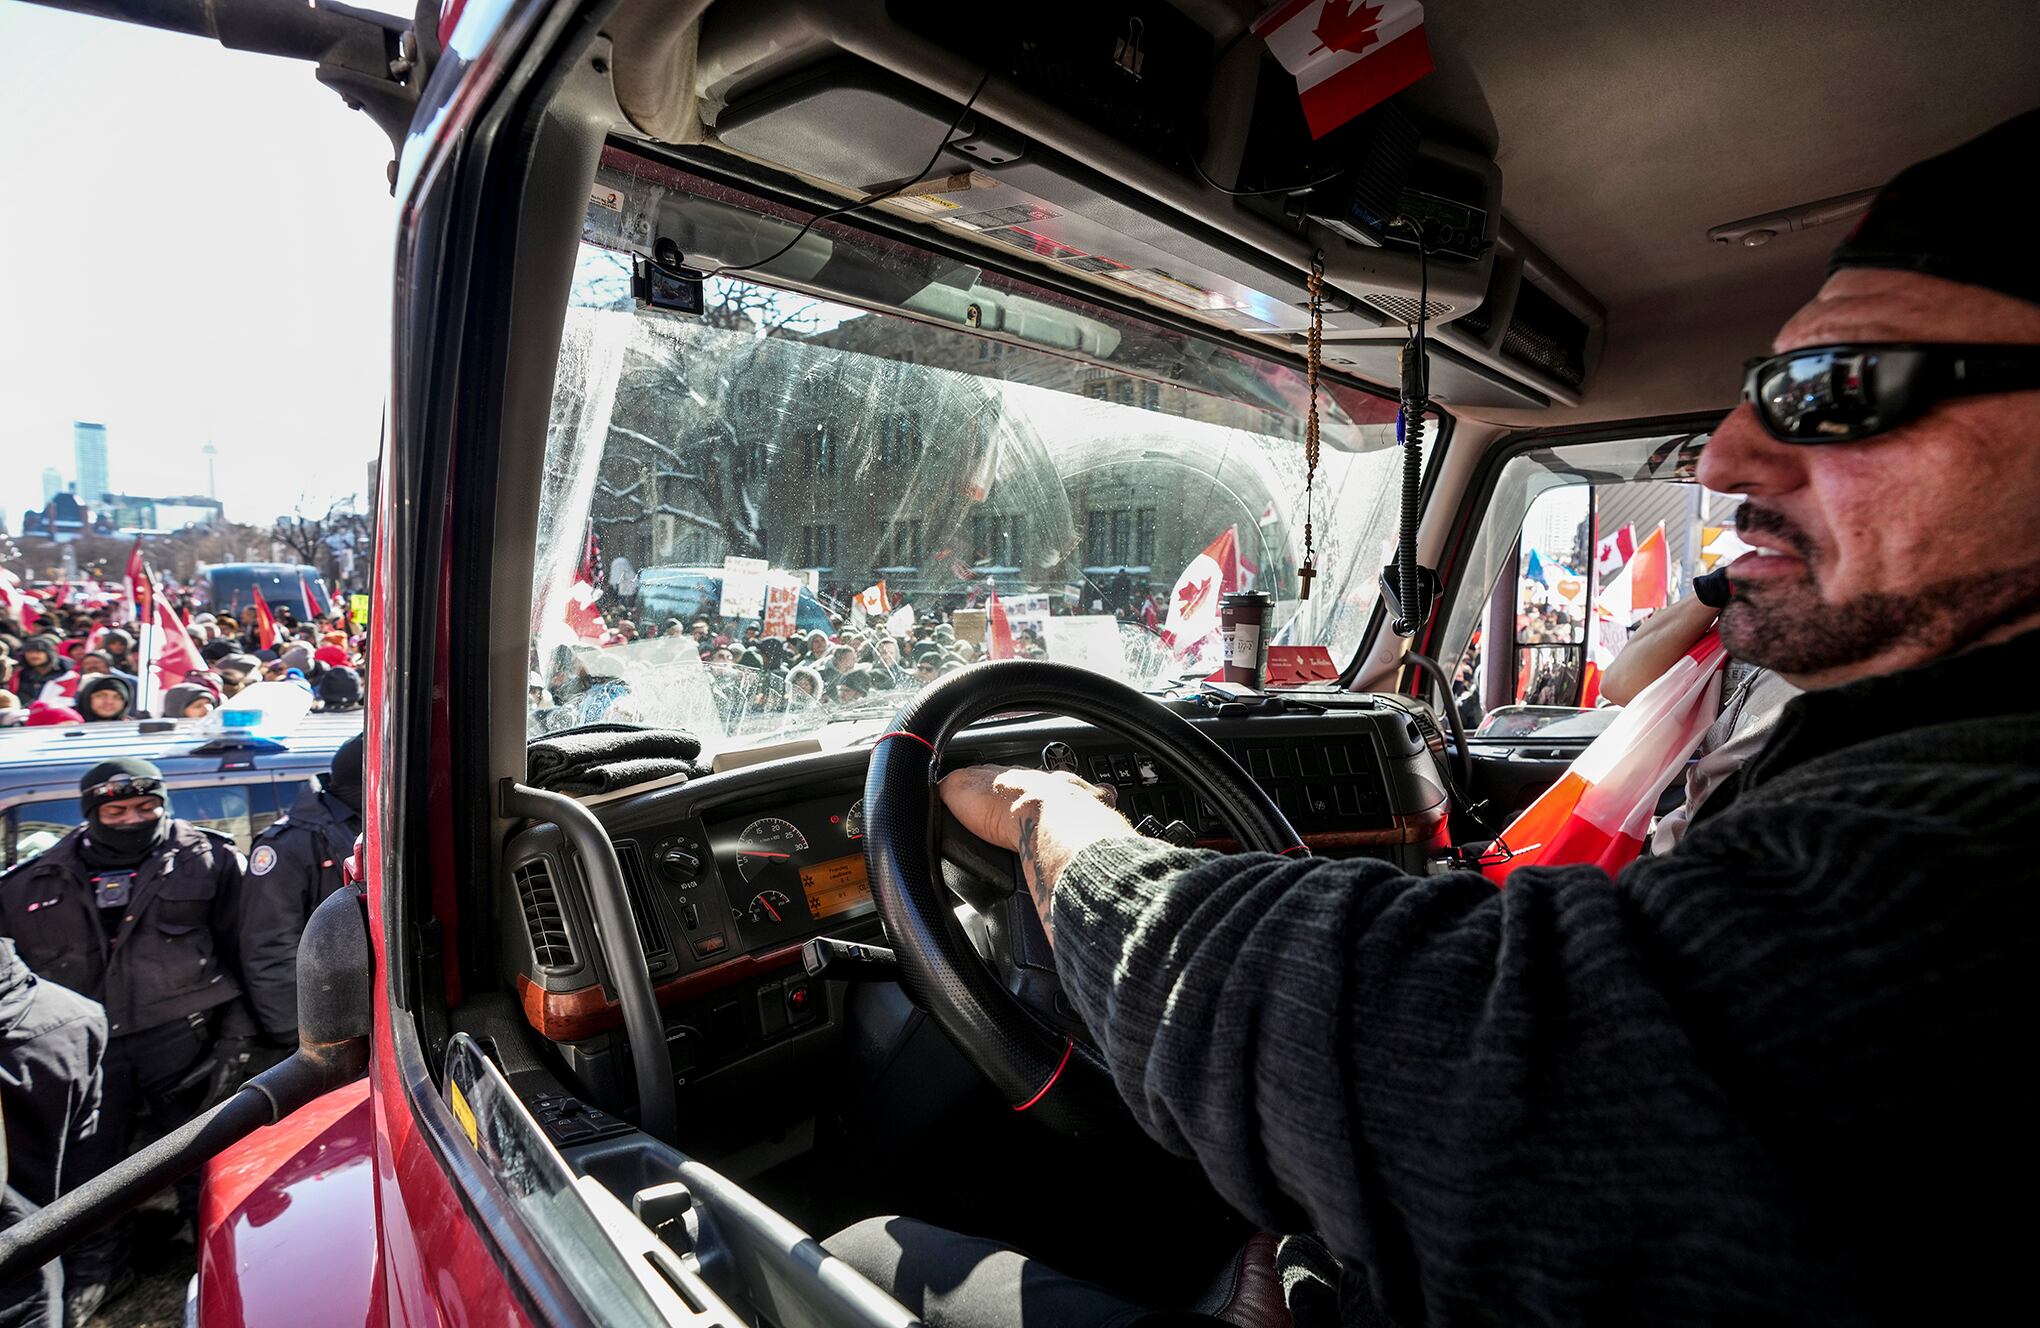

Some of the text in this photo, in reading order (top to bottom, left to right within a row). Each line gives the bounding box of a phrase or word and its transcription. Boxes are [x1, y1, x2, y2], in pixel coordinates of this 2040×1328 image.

[755, 827, 763, 835] 15
[771, 824, 781, 832] 20
[785, 831, 794, 840] 25
[743, 856, 749, 864] 5
